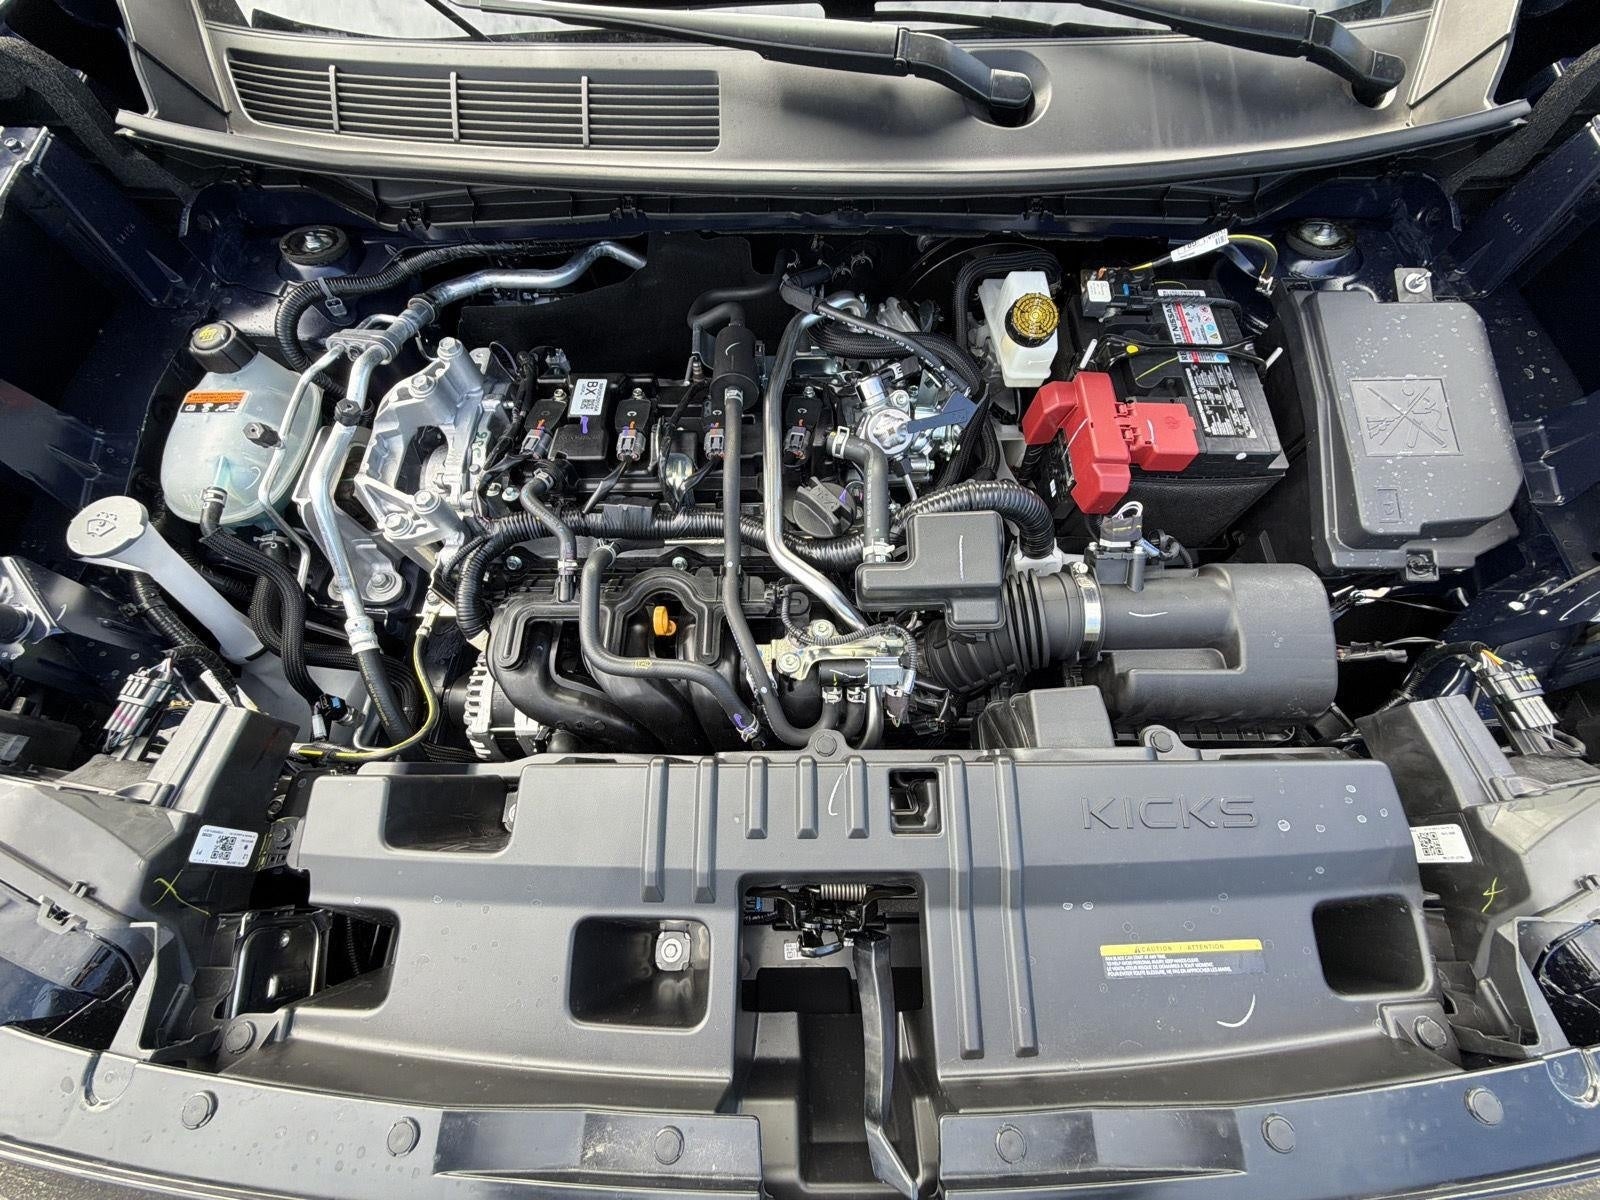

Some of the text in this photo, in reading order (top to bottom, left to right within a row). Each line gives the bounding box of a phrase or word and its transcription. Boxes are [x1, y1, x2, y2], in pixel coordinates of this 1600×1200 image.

[585, 381, 599, 396] BX
[1080, 794, 1258, 829] KICKS
[1187, 944, 1225, 952] ATTENTION
